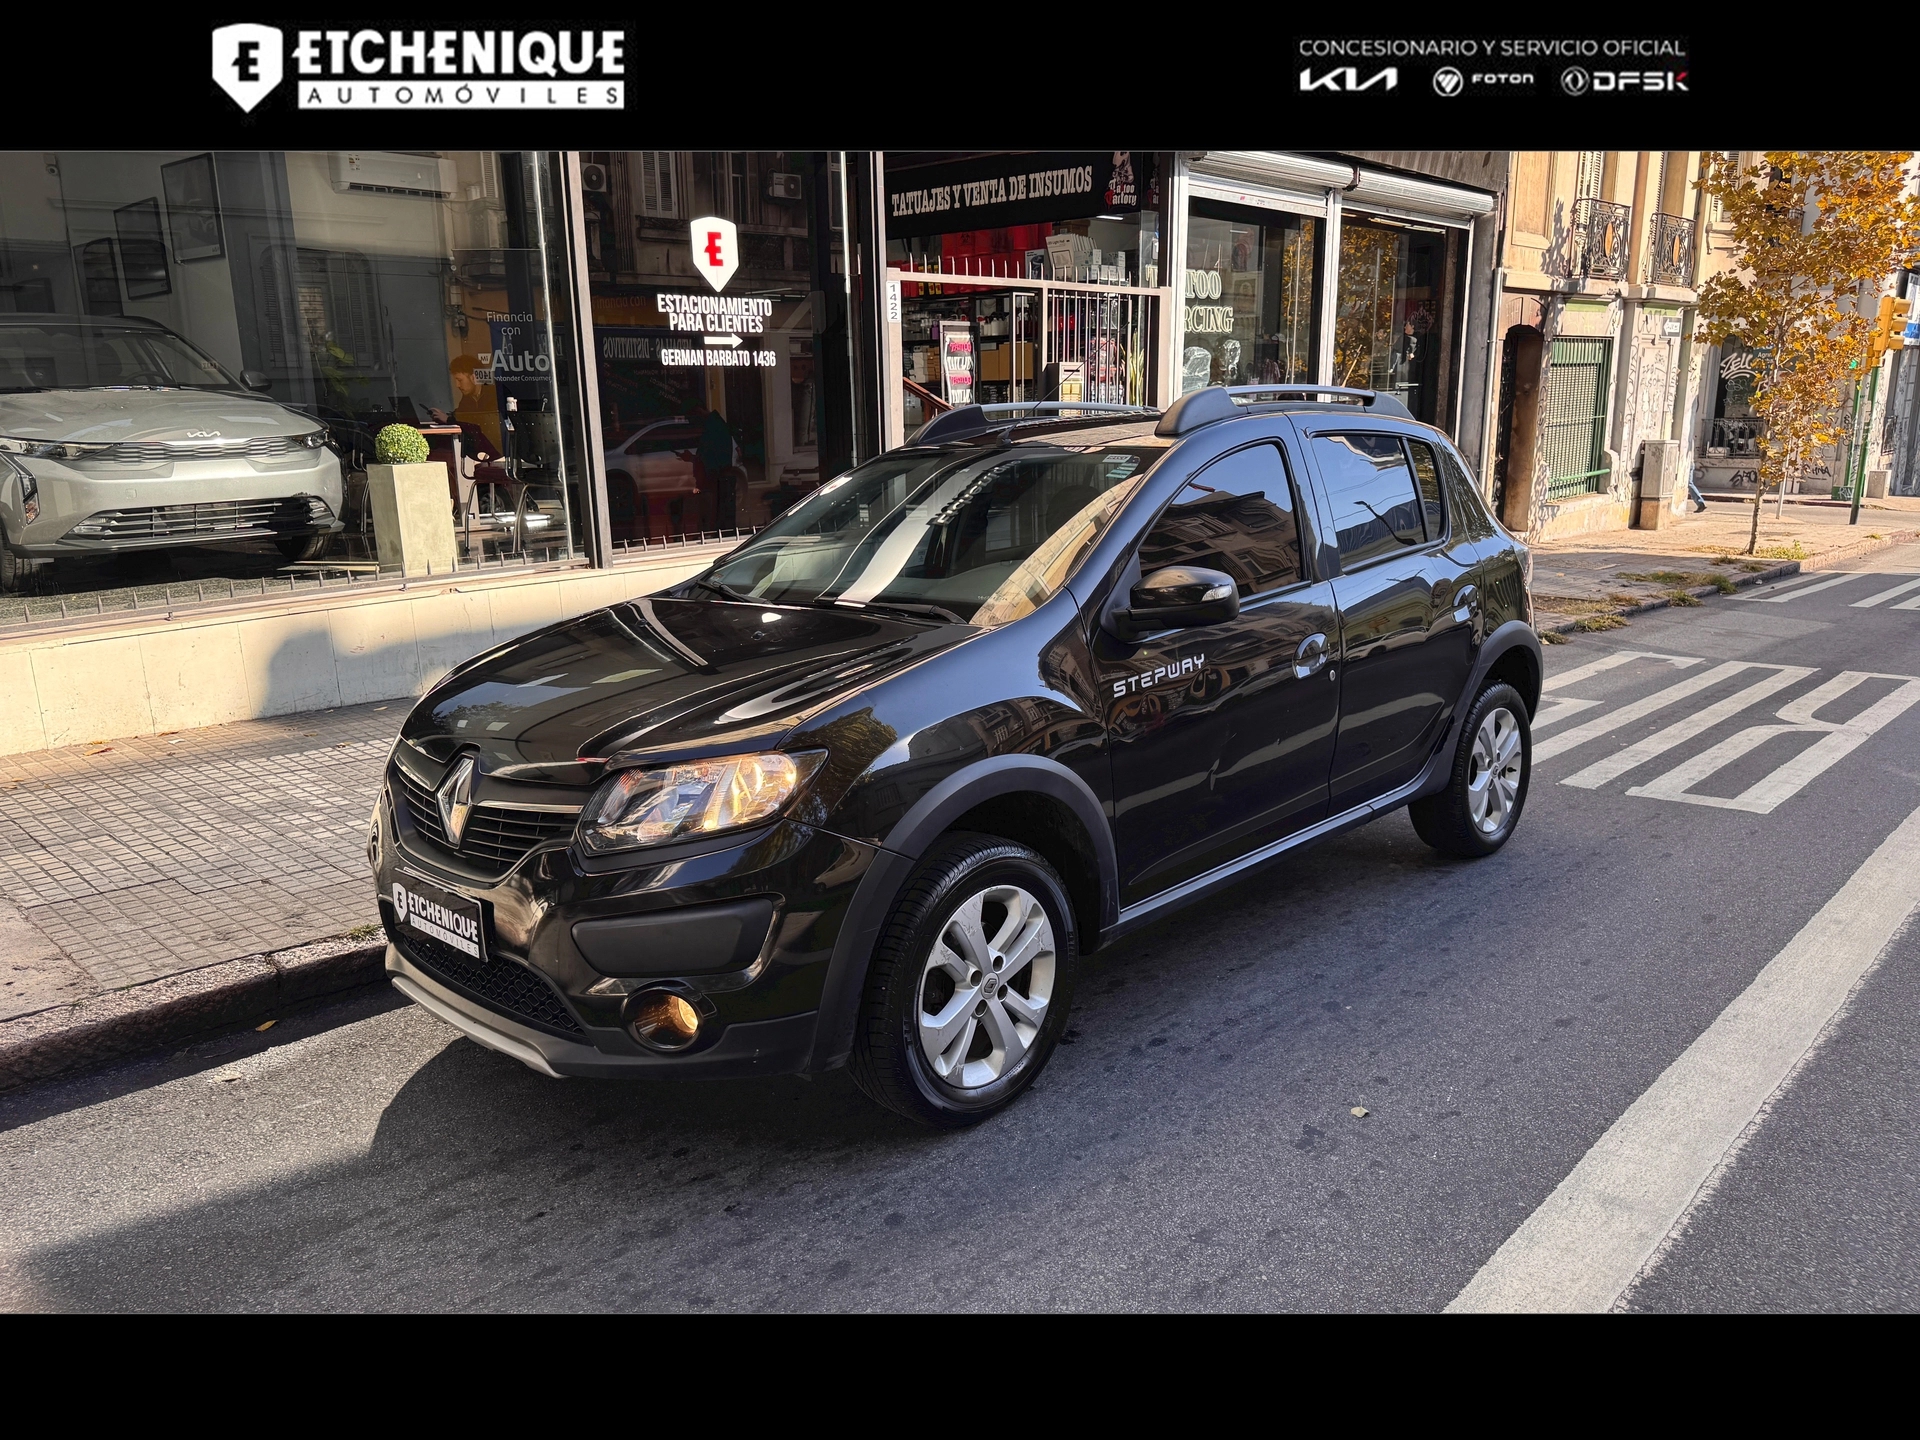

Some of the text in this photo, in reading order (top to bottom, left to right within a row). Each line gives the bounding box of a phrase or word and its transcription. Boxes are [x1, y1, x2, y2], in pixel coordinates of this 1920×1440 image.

[892, 165, 1093, 217] TATUAJES Y VENTA DE INSUMOS
[657, 293, 773, 317] ESTACIONAMIENTO
[890, 284, 898, 320] 1422
[486, 311, 533, 323] Financia
[669, 312, 764, 333] PARA CLIENTES
[501, 326, 521, 335] con
[490, 349, 550, 372] Auto
[661, 349, 777, 367] GERMAN BARBATO 1436
[1113, 653, 1205, 698] STEPWAY
[407, 891, 479, 943] ETCHENIQUE
